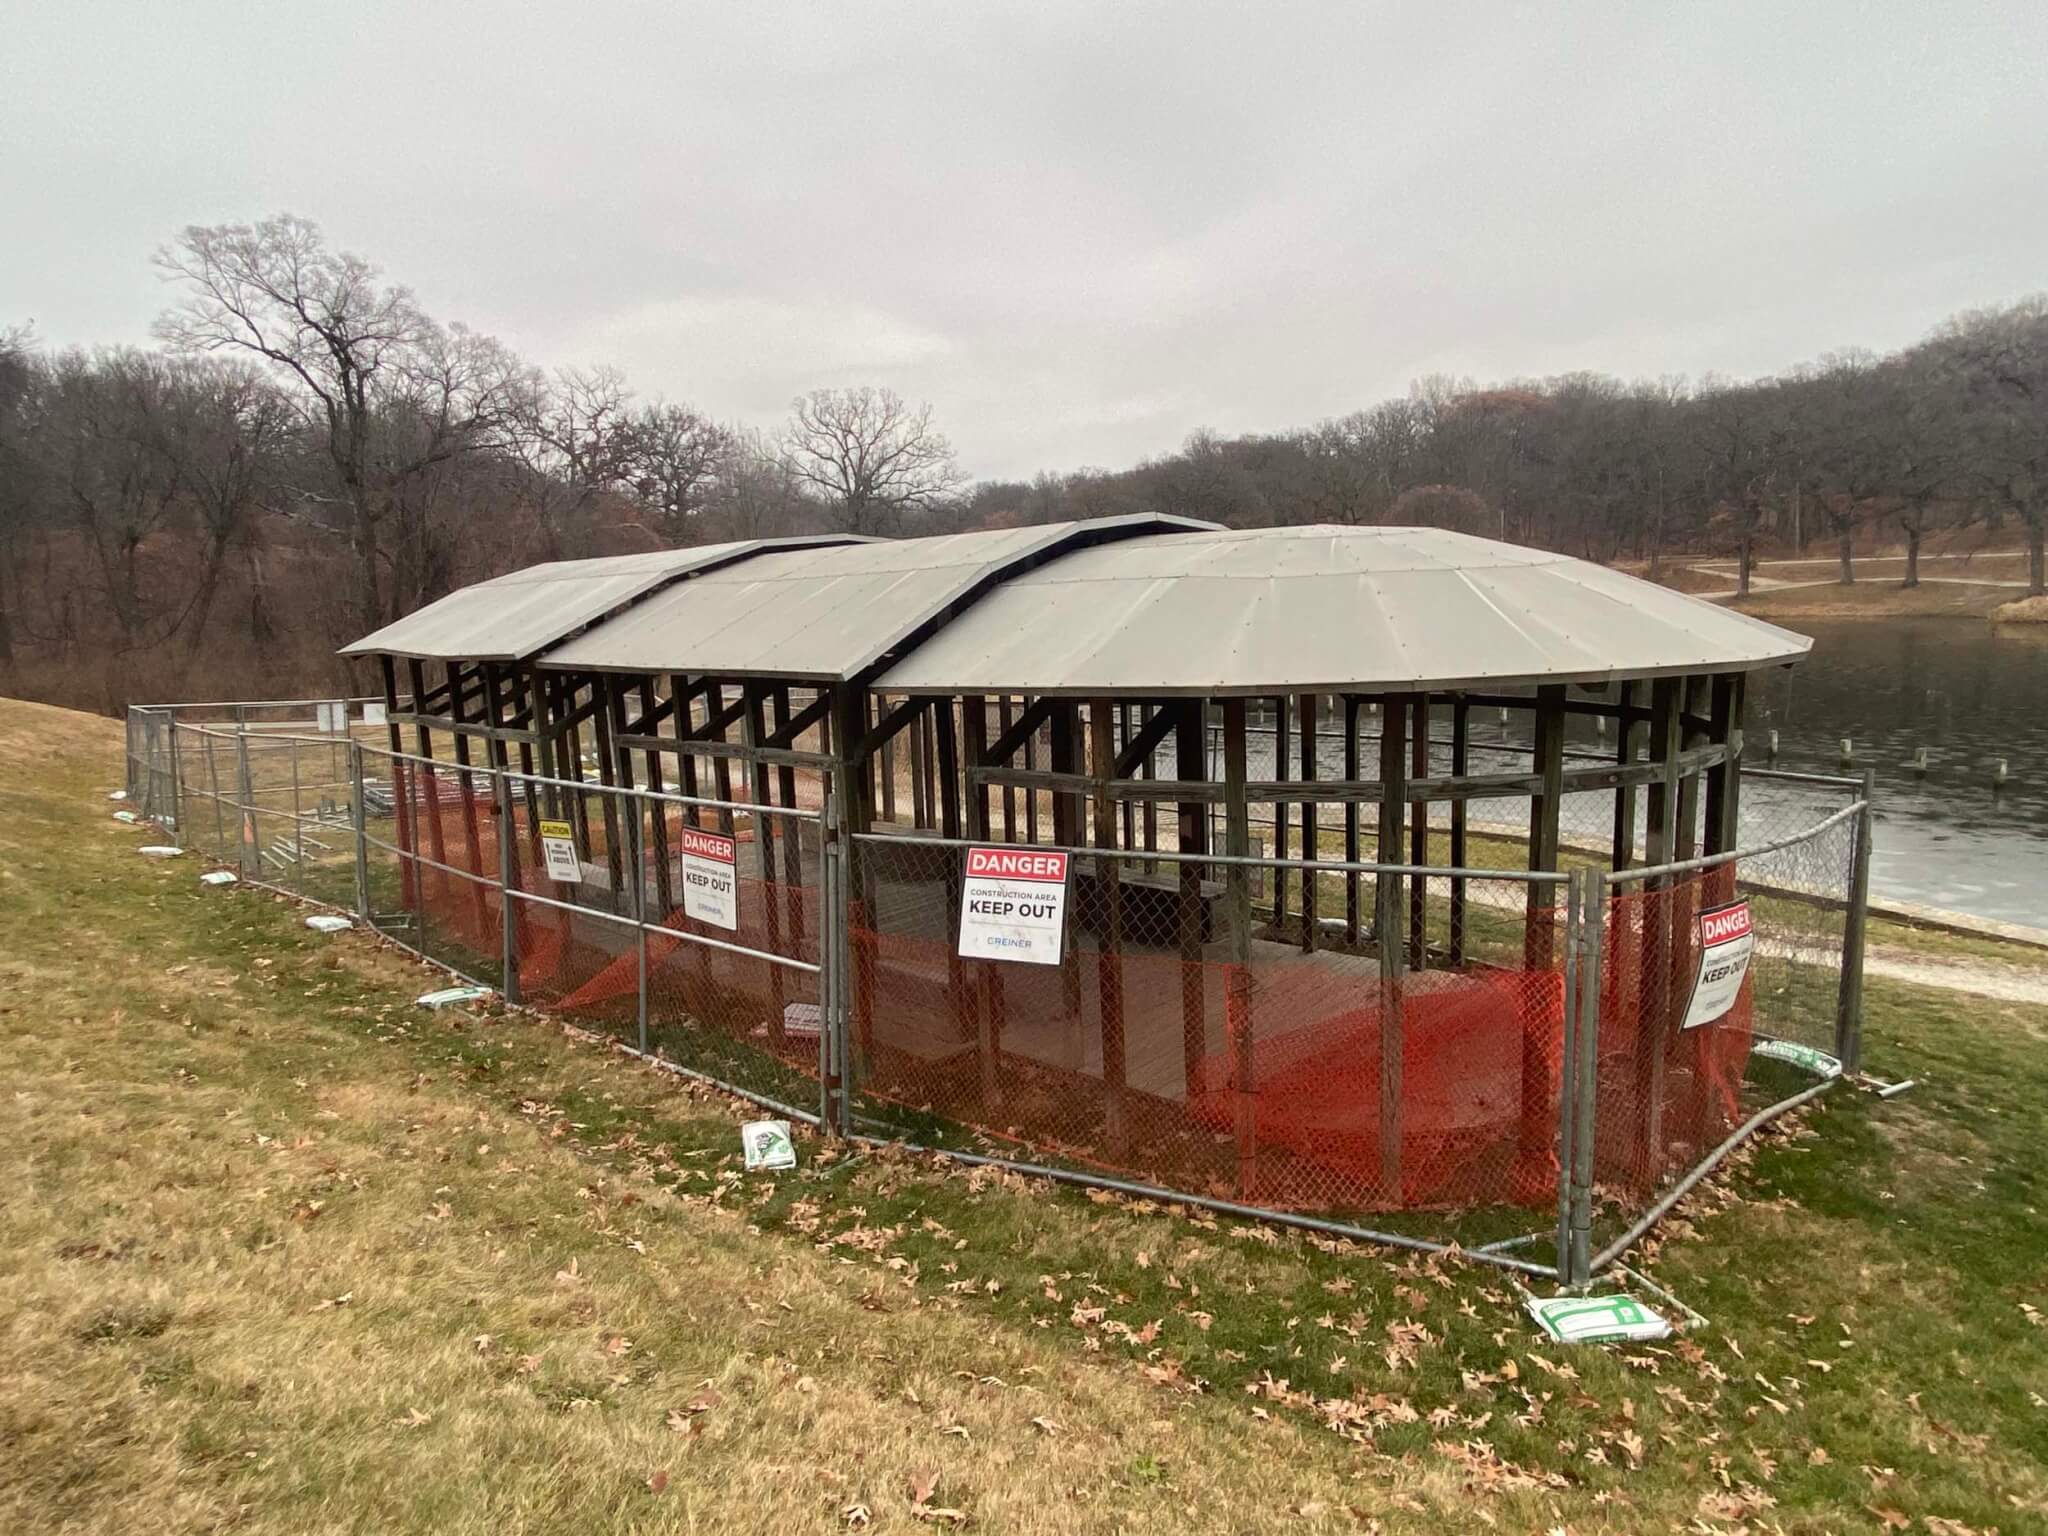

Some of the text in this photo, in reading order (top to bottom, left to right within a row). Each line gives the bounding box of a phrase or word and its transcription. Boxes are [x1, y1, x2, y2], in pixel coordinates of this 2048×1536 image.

[684, 834, 732, 857] DANGER
[972, 854, 1061, 875] DANGER
[686, 871, 731, 893] KEEP OUT
[970, 889, 1057, 902] CONSTRUCTION AREA
[969, 900, 1056, 919] KEEP OUT
[1702, 965, 1730, 985] KEEP
